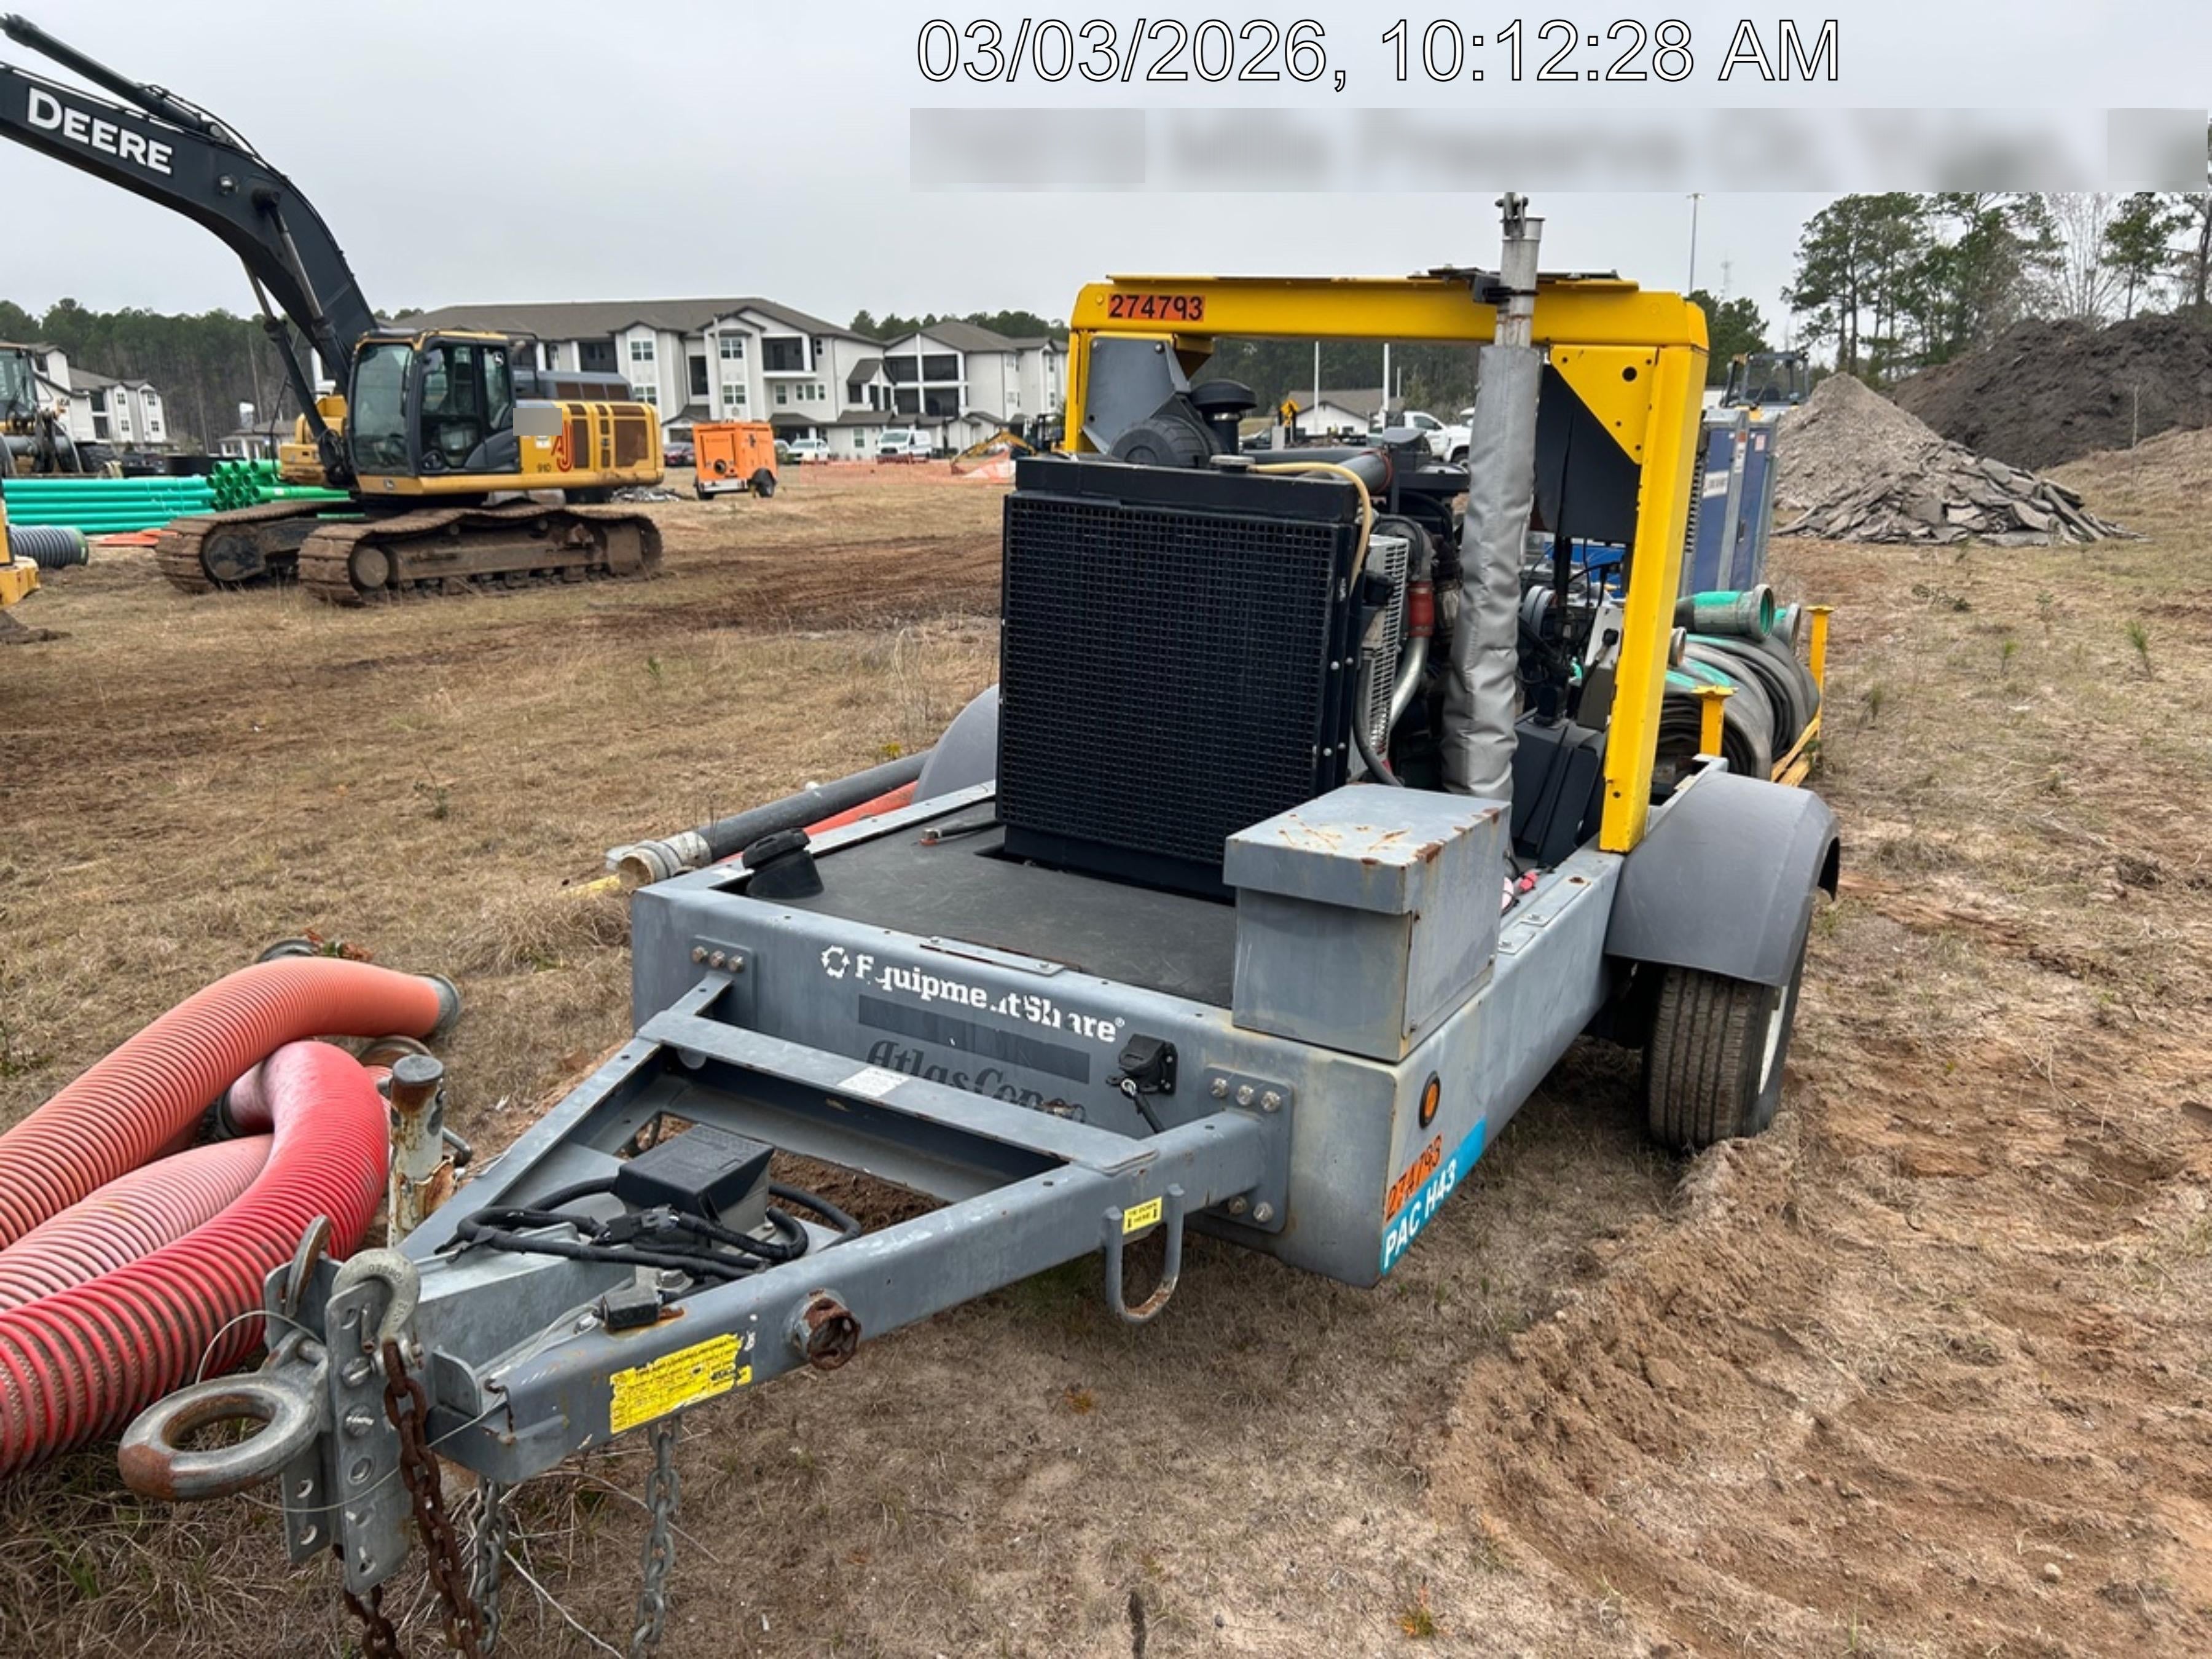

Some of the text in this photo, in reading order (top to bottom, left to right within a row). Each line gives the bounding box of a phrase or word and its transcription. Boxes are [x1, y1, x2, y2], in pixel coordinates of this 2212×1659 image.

[28, 87, 173, 176] DEERE
[1109, 294, 1202, 321] 274793
[1384, 1158, 1457, 1269] PAC H43
